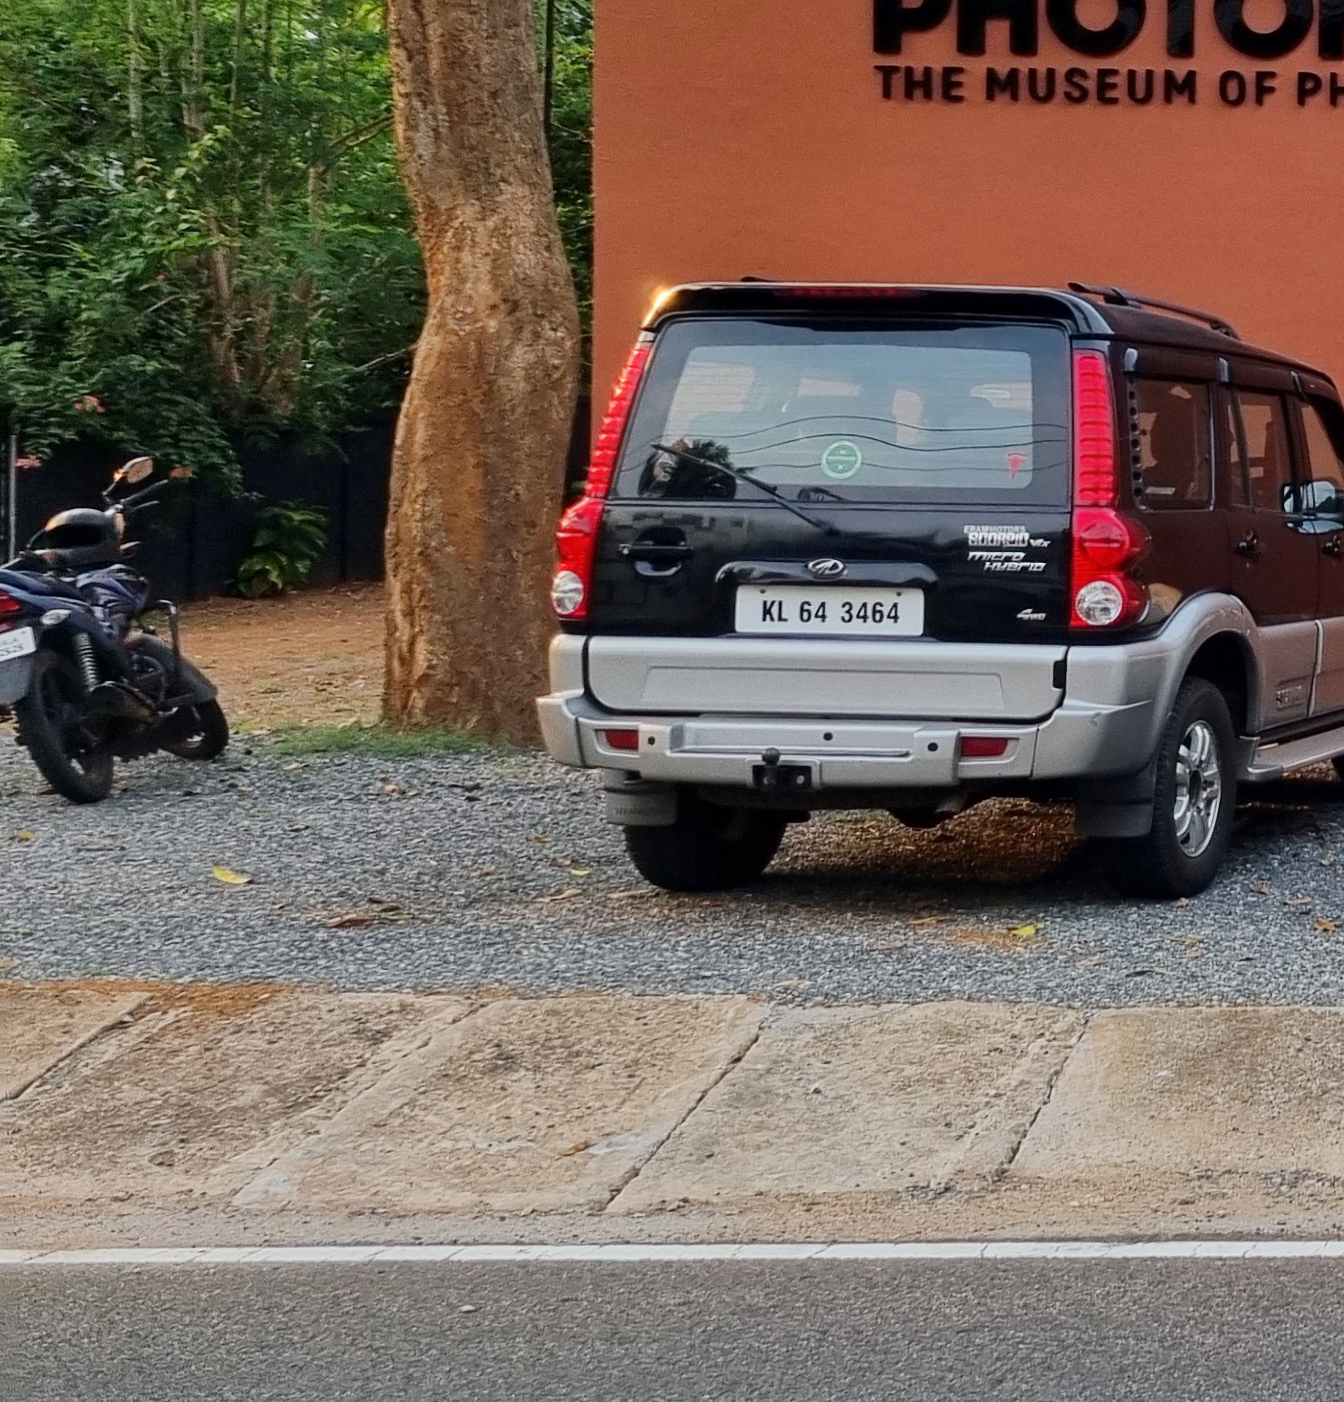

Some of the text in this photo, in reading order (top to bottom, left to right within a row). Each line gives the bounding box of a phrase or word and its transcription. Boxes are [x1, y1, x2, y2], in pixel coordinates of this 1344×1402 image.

[873, 65, 966, 104] THE
[985, 67, 1198, 106] MUSEUM
[1218, 69, 1279, 108] OF
[761, 600, 900, 625] KL 64 3464
